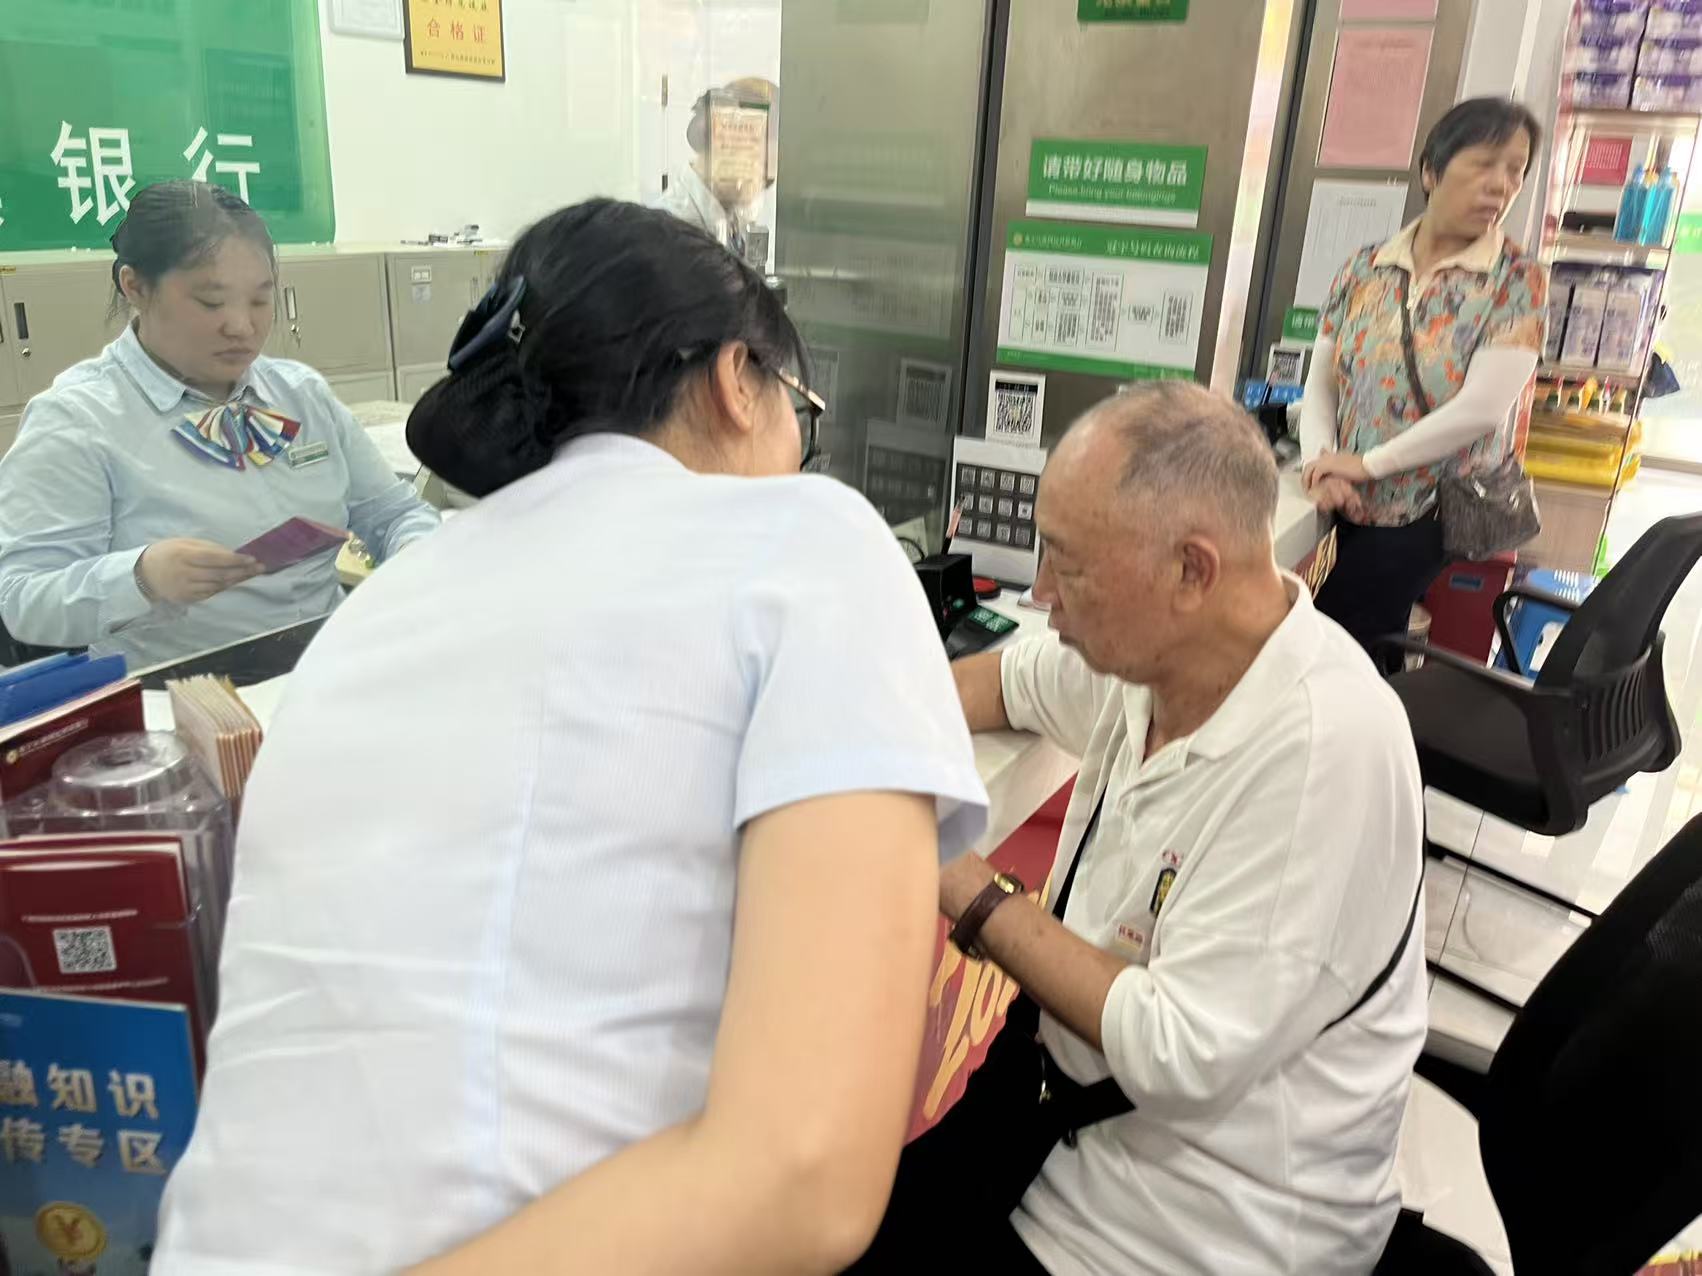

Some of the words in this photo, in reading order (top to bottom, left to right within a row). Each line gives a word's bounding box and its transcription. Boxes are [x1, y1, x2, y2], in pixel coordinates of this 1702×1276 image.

[426, 18, 486, 43] 合格证
[0, 120, 260, 226] 银行
[1042, 153, 1187, 186] 请带好随身物品
